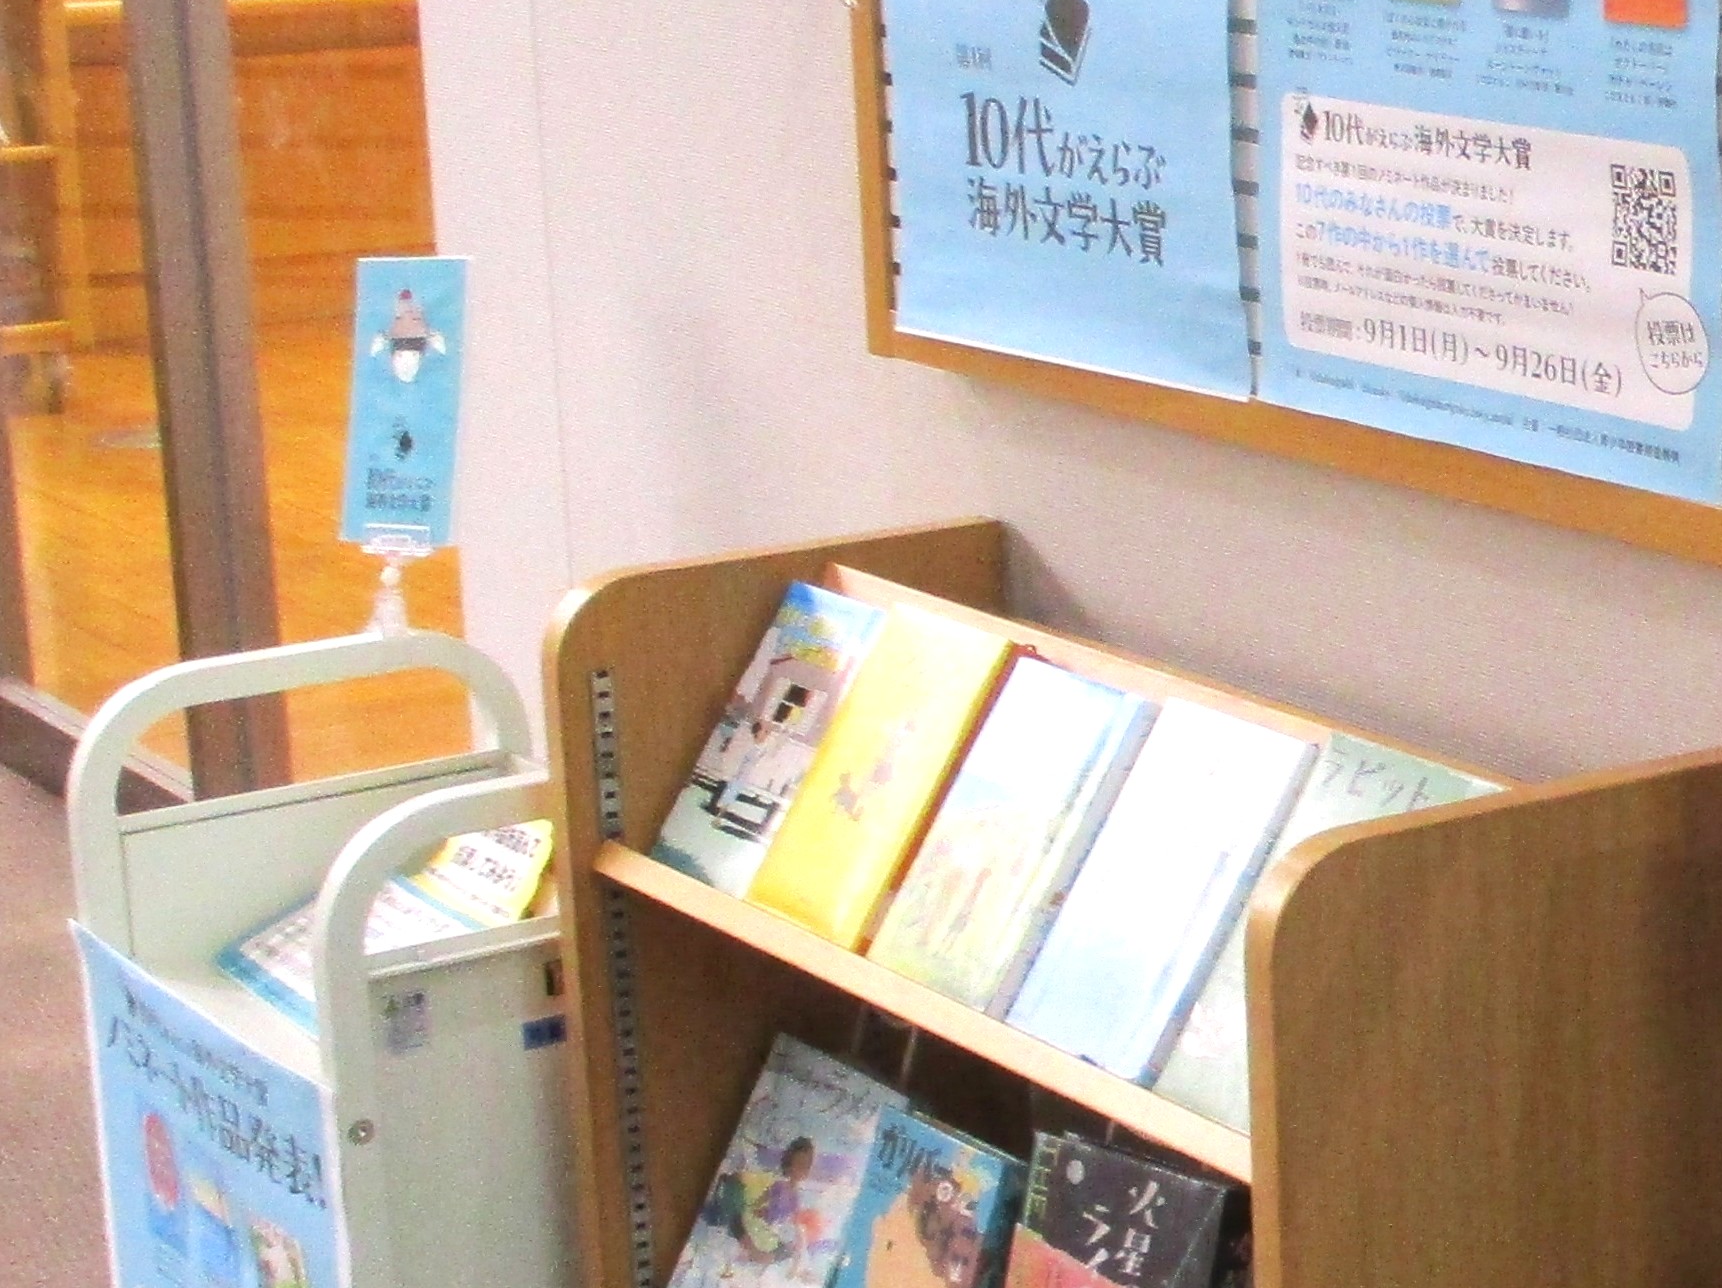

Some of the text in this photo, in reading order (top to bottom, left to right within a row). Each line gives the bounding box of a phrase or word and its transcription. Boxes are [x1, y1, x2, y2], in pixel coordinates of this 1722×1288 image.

[960, 91, 1166, 190] 10代がえらぶ
[967, 176, 1167, 267] 海外文学大賞
